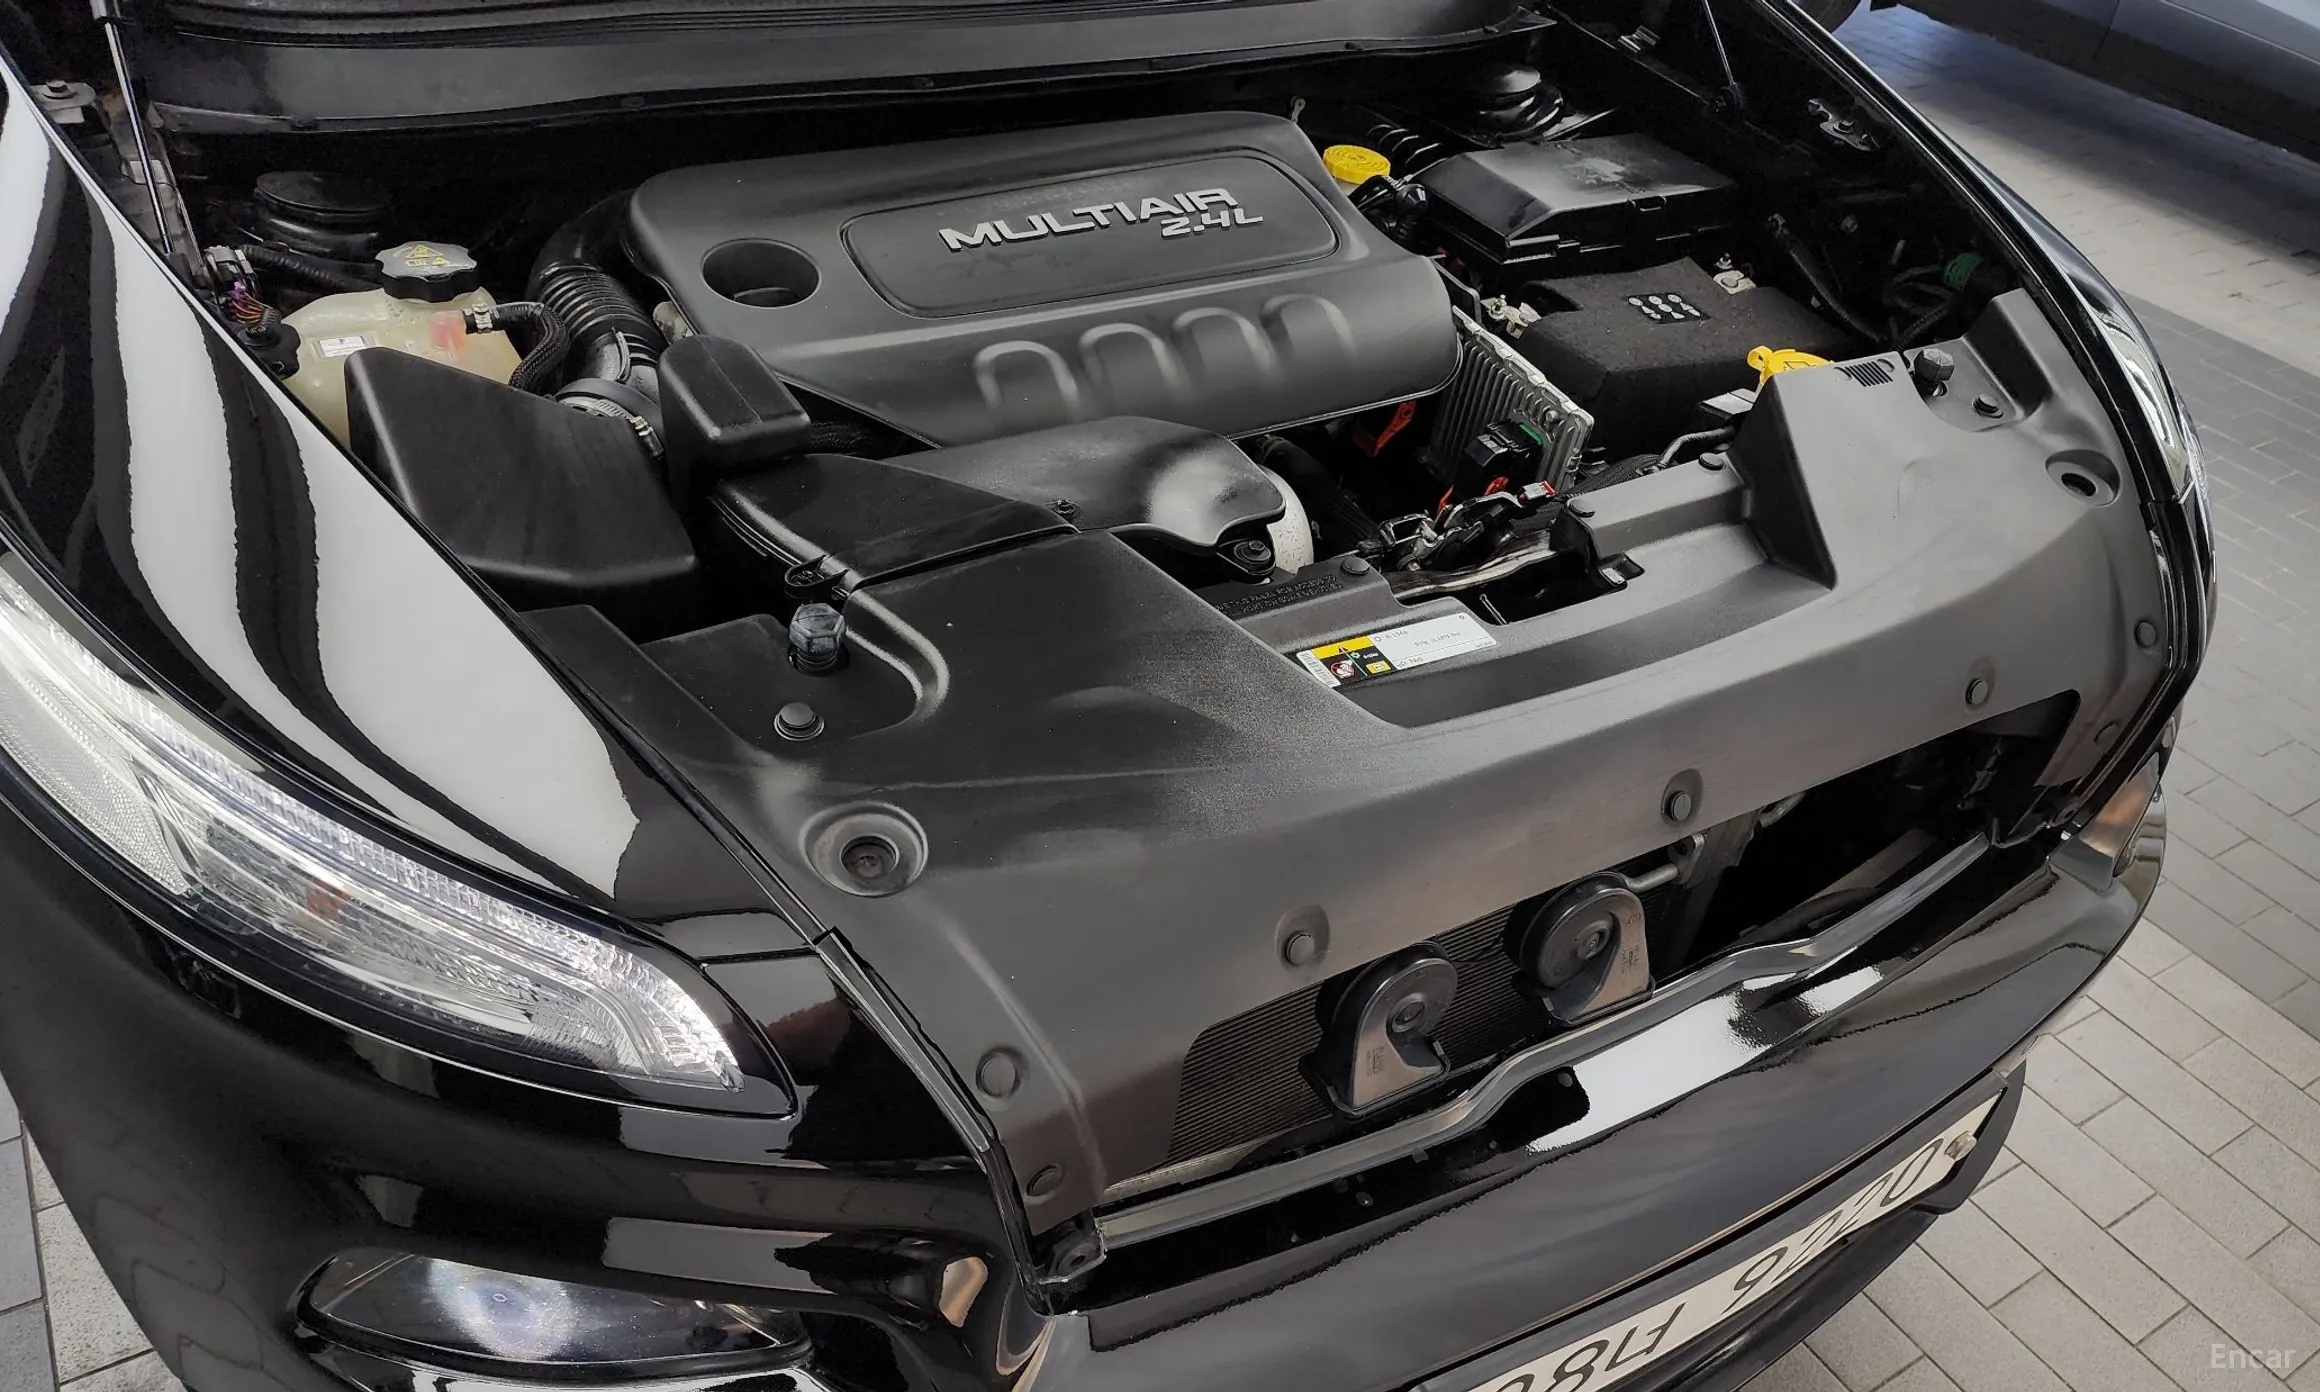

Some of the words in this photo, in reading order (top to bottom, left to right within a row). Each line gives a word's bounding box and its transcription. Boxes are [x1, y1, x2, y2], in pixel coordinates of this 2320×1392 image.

[939, 187, 1239, 251] MULTIAIR
[1161, 207, 1264, 238] 2.4L
[1721, 1138, 1944, 1315] 9220
